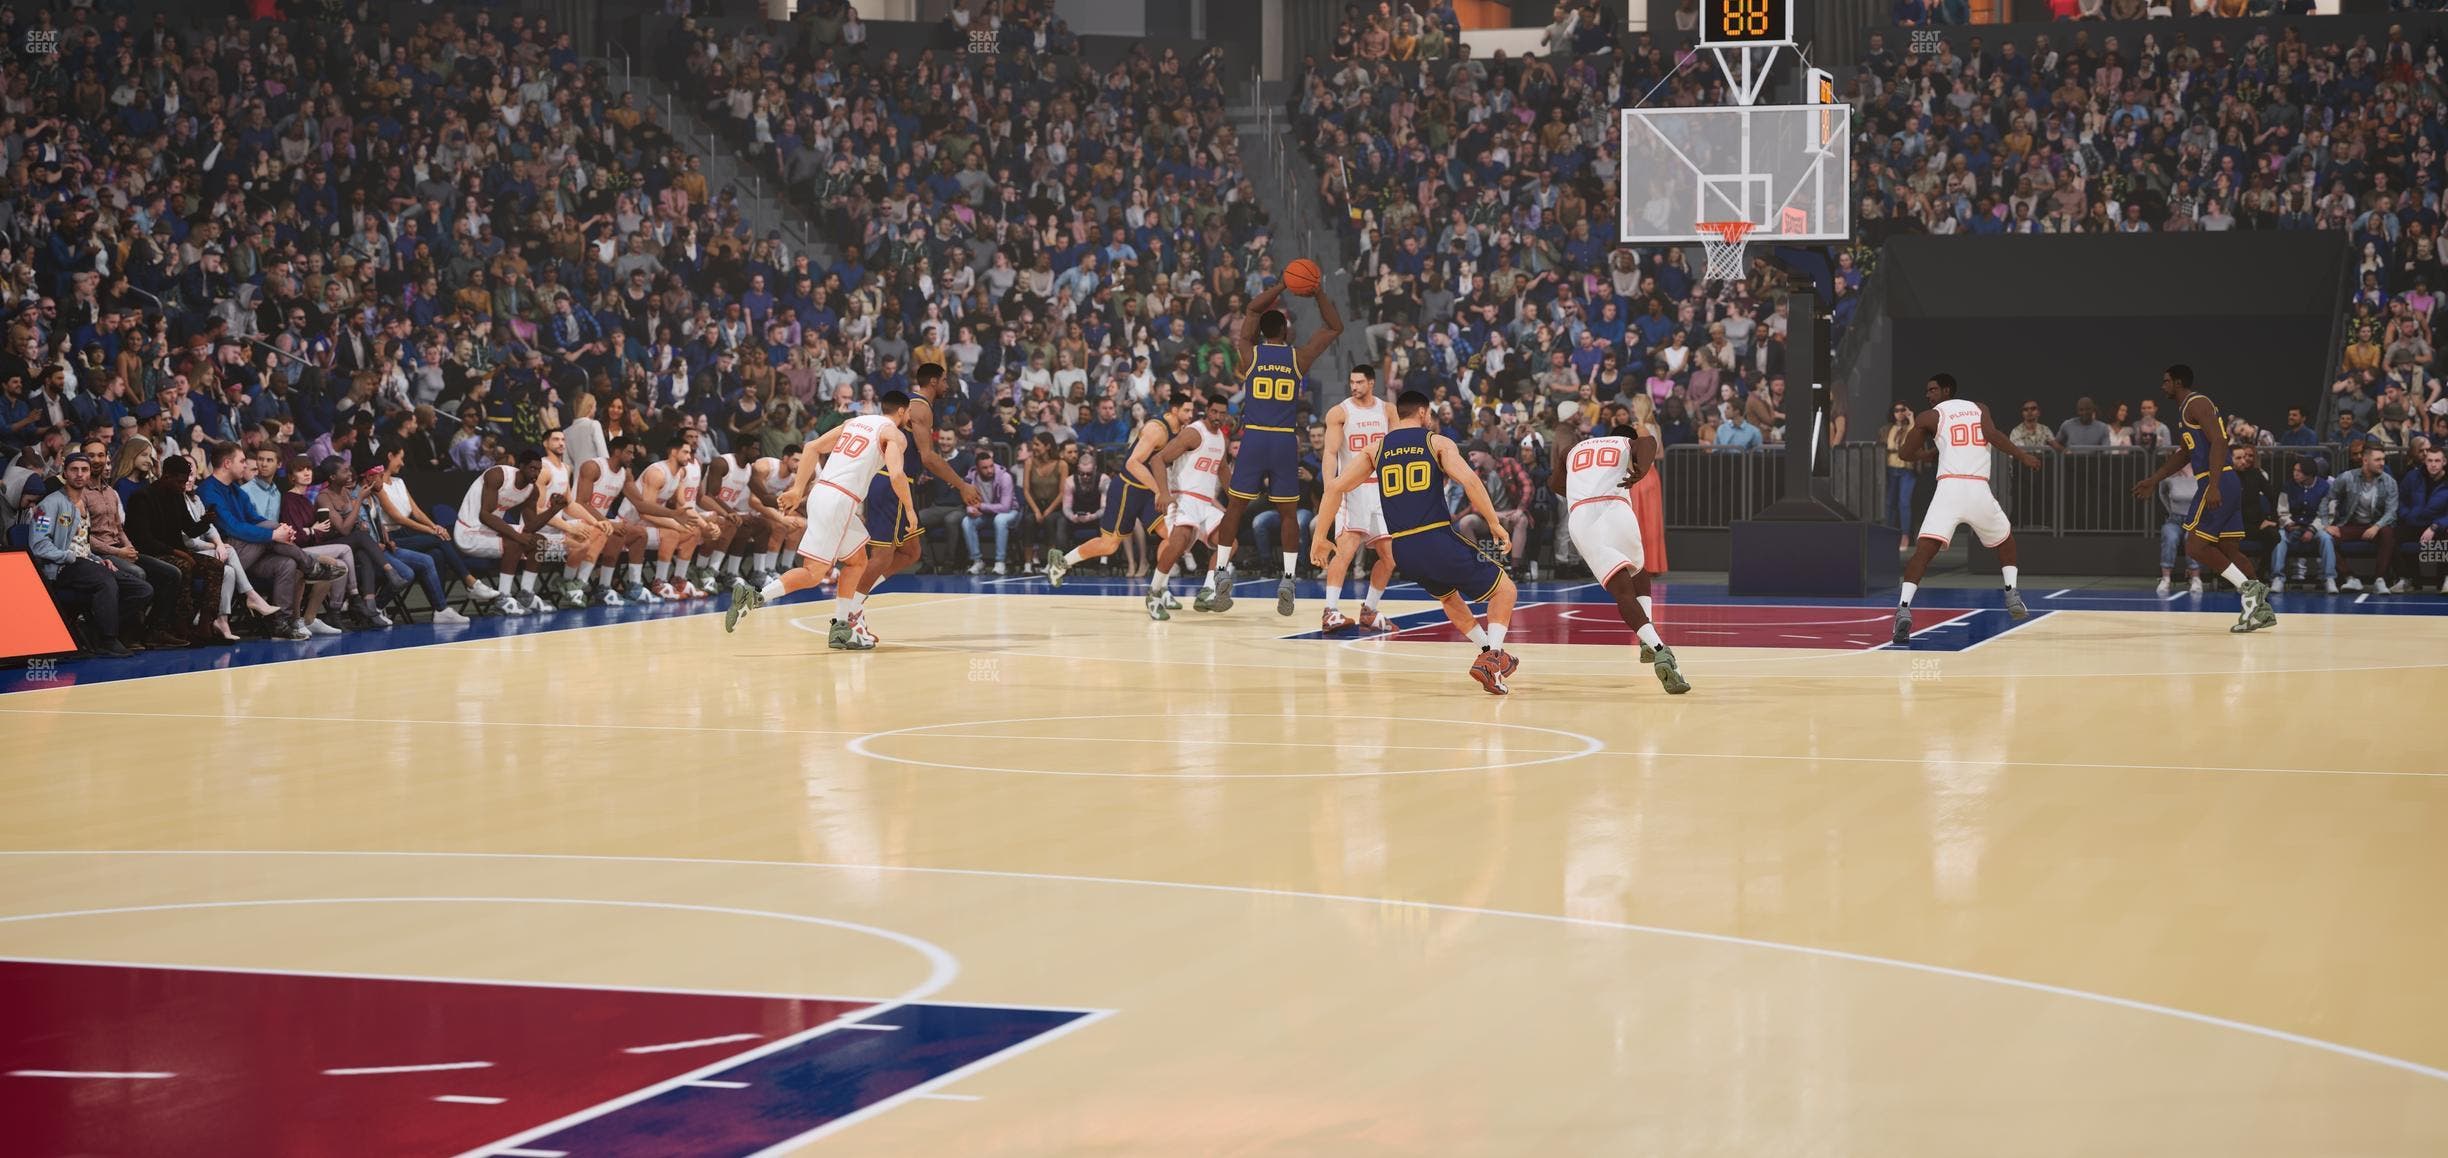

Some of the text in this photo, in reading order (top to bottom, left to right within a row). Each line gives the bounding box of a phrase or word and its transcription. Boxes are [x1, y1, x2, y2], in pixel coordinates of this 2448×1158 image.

[1257, 364, 1292, 374] PLAYER
[1253, 376, 1295, 401] 00
[1357, 420, 1380, 428] TEAM
[1383, 446, 1425, 460] PLAYER
[1572, 447, 1621, 472] 00
[1381, 460, 1431, 498] 00
